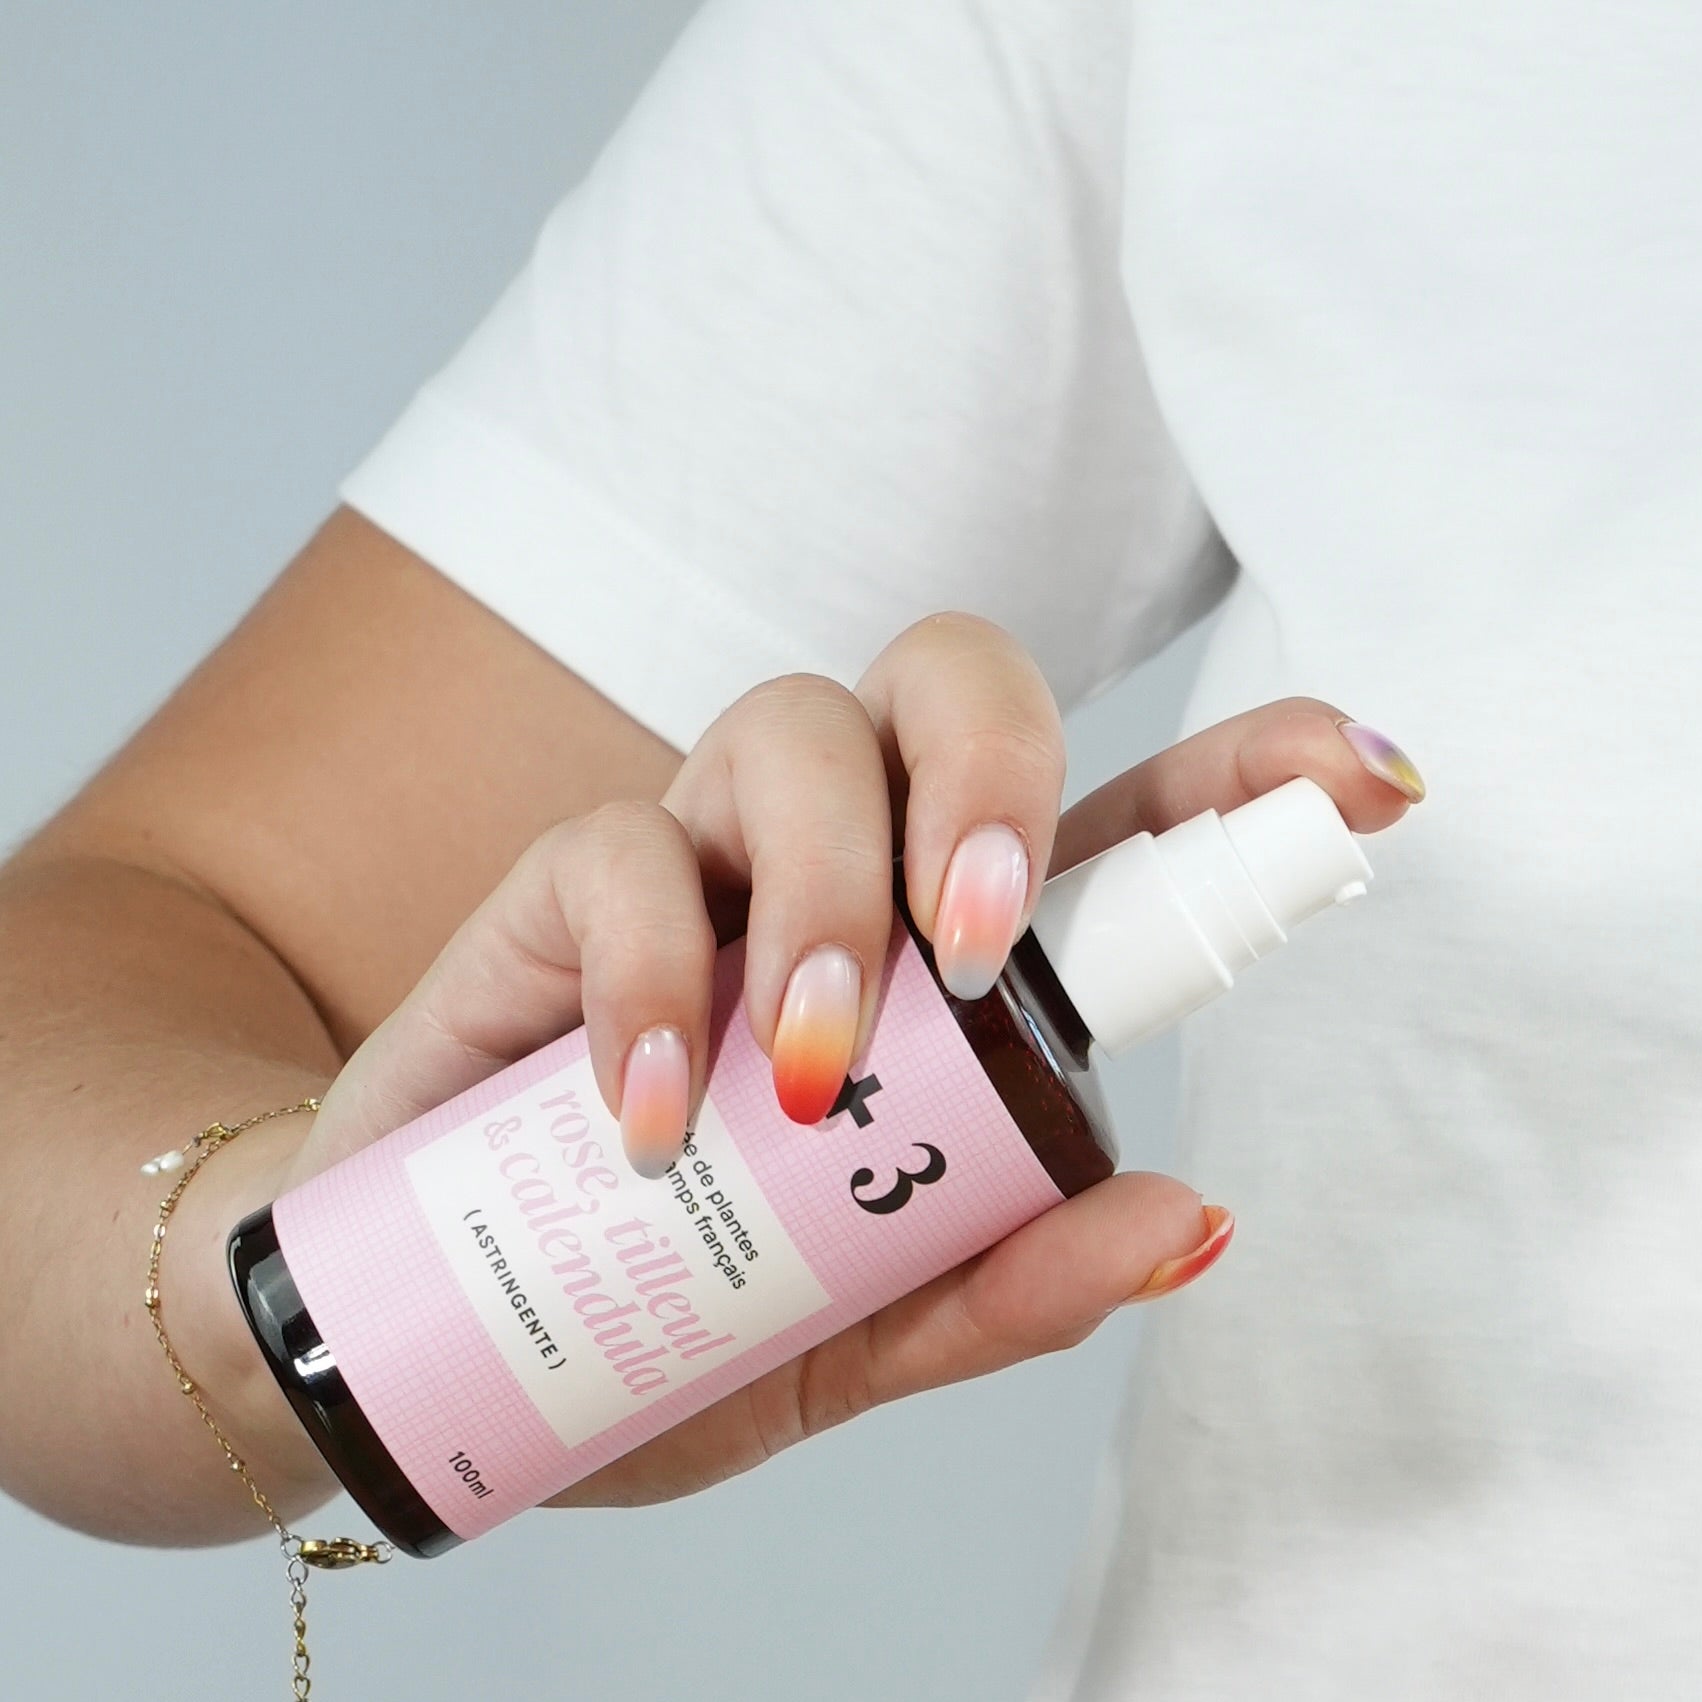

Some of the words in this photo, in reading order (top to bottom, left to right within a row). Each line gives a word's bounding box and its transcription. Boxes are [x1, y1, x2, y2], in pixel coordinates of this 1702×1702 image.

[483, 1115, 523, 1151] &
[693, 1160, 714, 1187] de
[705, 1190, 759, 1262] plantes
[850, 1143, 947, 1214] 3
[471, 1223, 558, 1359] ASTRINGENTE
[499, 1152, 671, 1396] calendula
[604, 1217, 738, 1361] tilleul
[694, 1216, 746, 1290] français
[448, 1451, 494, 1499] 100ml
